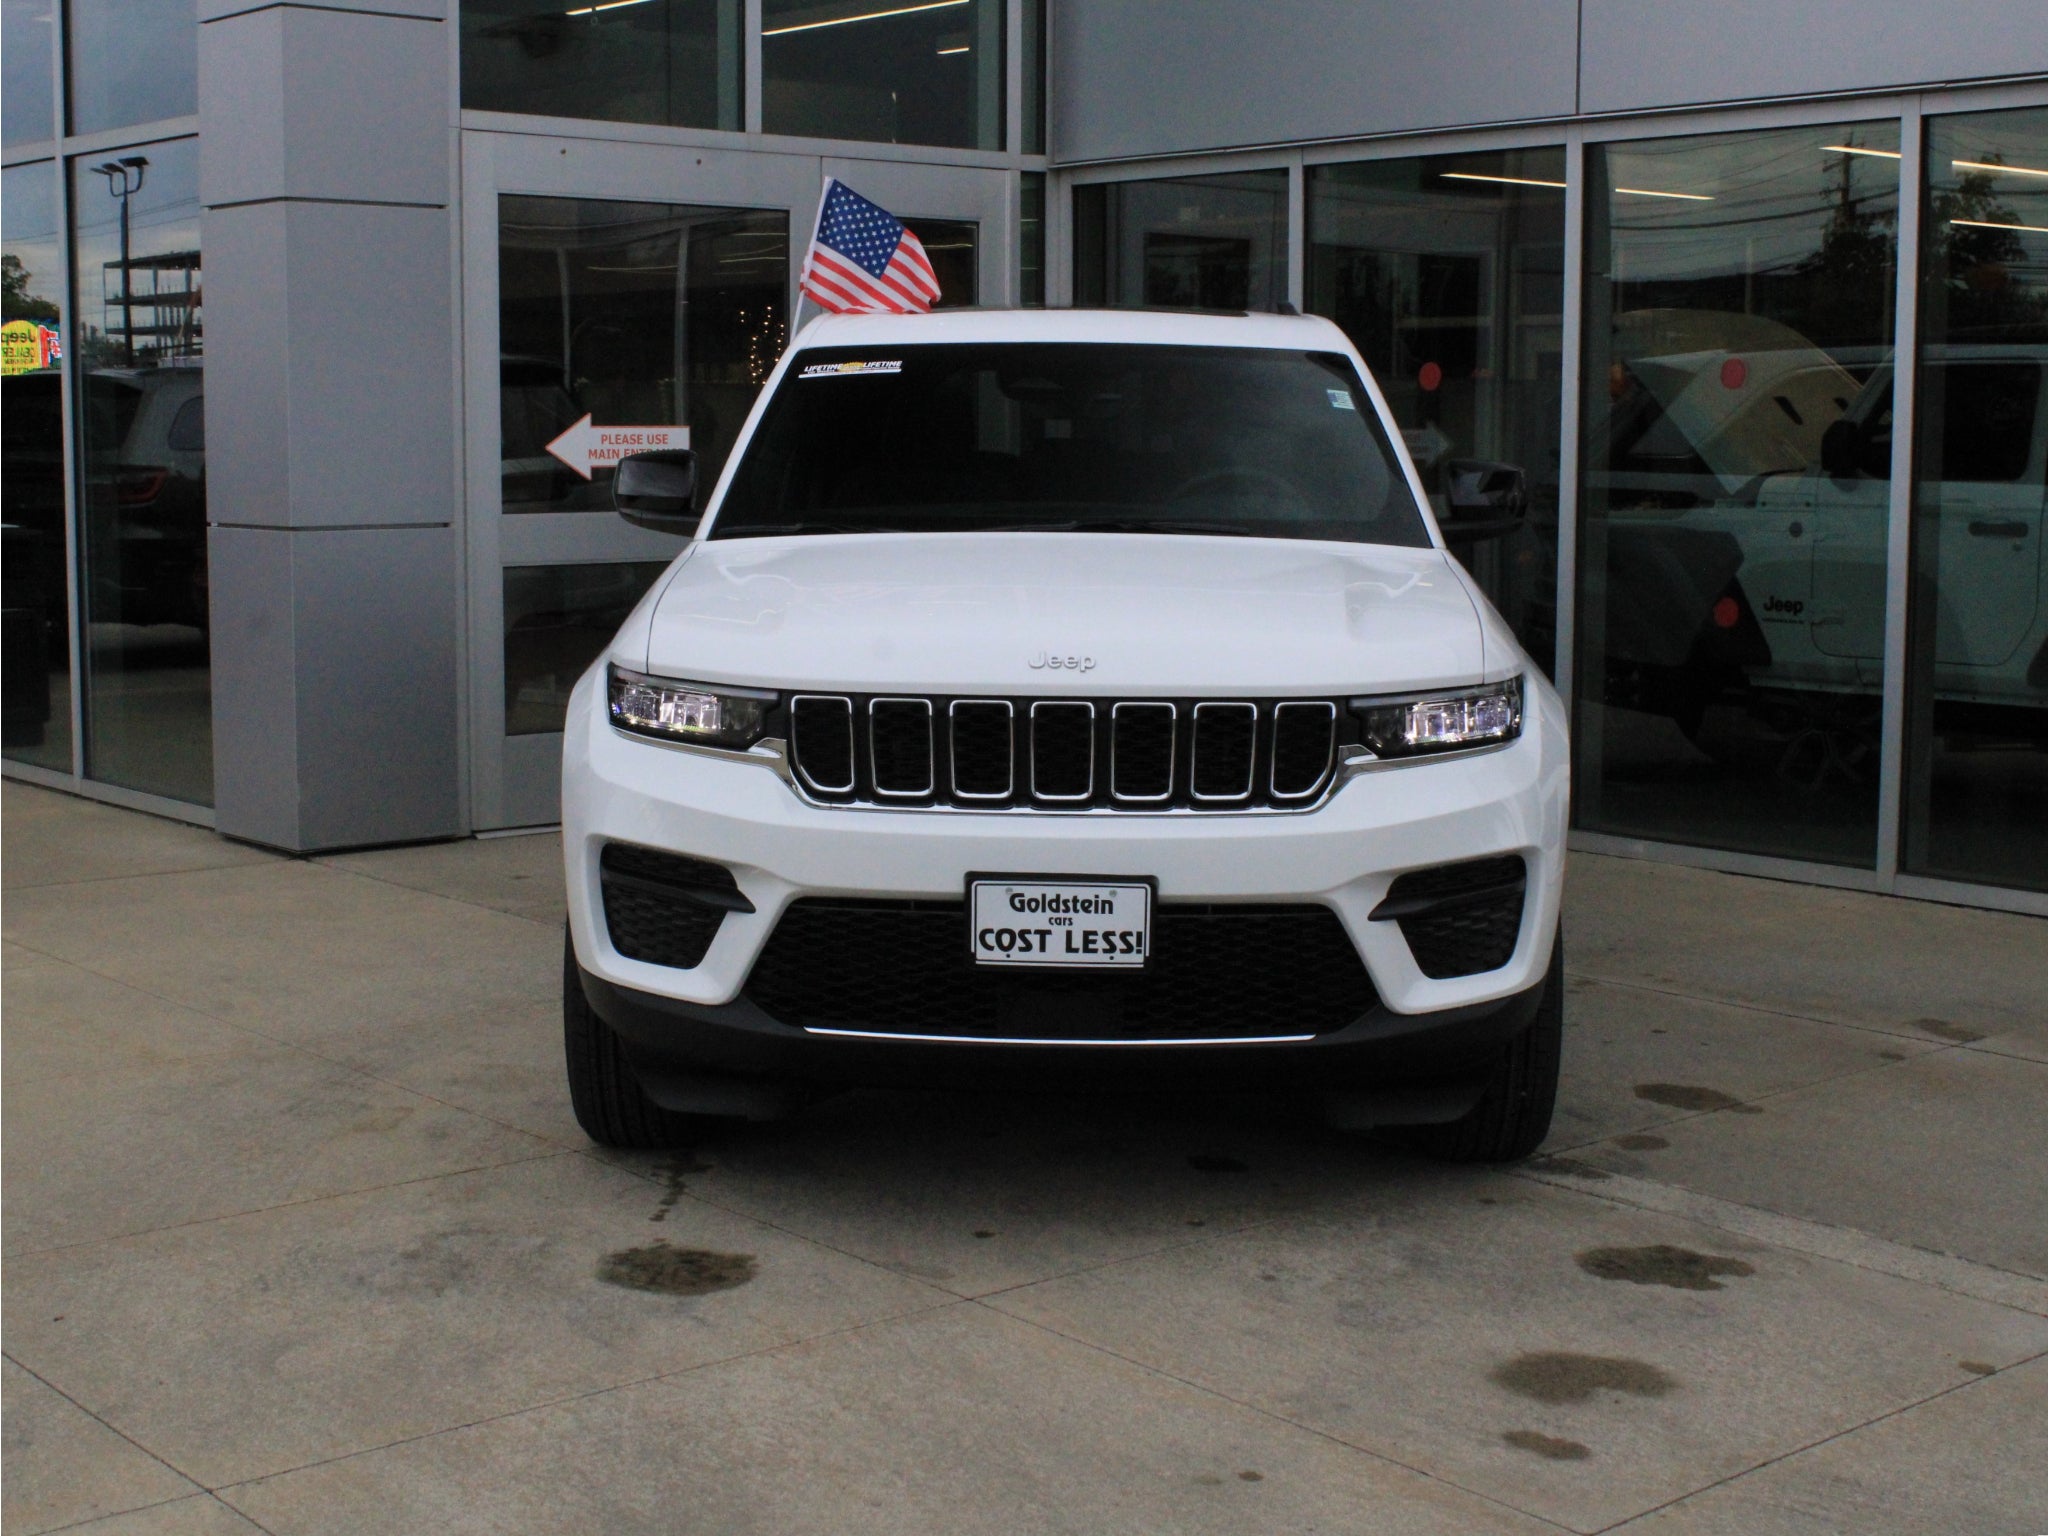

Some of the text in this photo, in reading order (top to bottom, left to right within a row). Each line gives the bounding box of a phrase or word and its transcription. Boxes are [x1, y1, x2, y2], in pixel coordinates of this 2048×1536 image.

[601, 433, 669, 445] PLEASE USE
[588, 448, 620, 459] MAIN
[1763, 595, 1804, 616] Jeep
[1028, 651, 1097, 673] Jeep
[1009, 892, 1113, 914] Goldstein
[1048, 916, 1073, 926] cars
[978, 928, 1143, 955] COST LESS!
